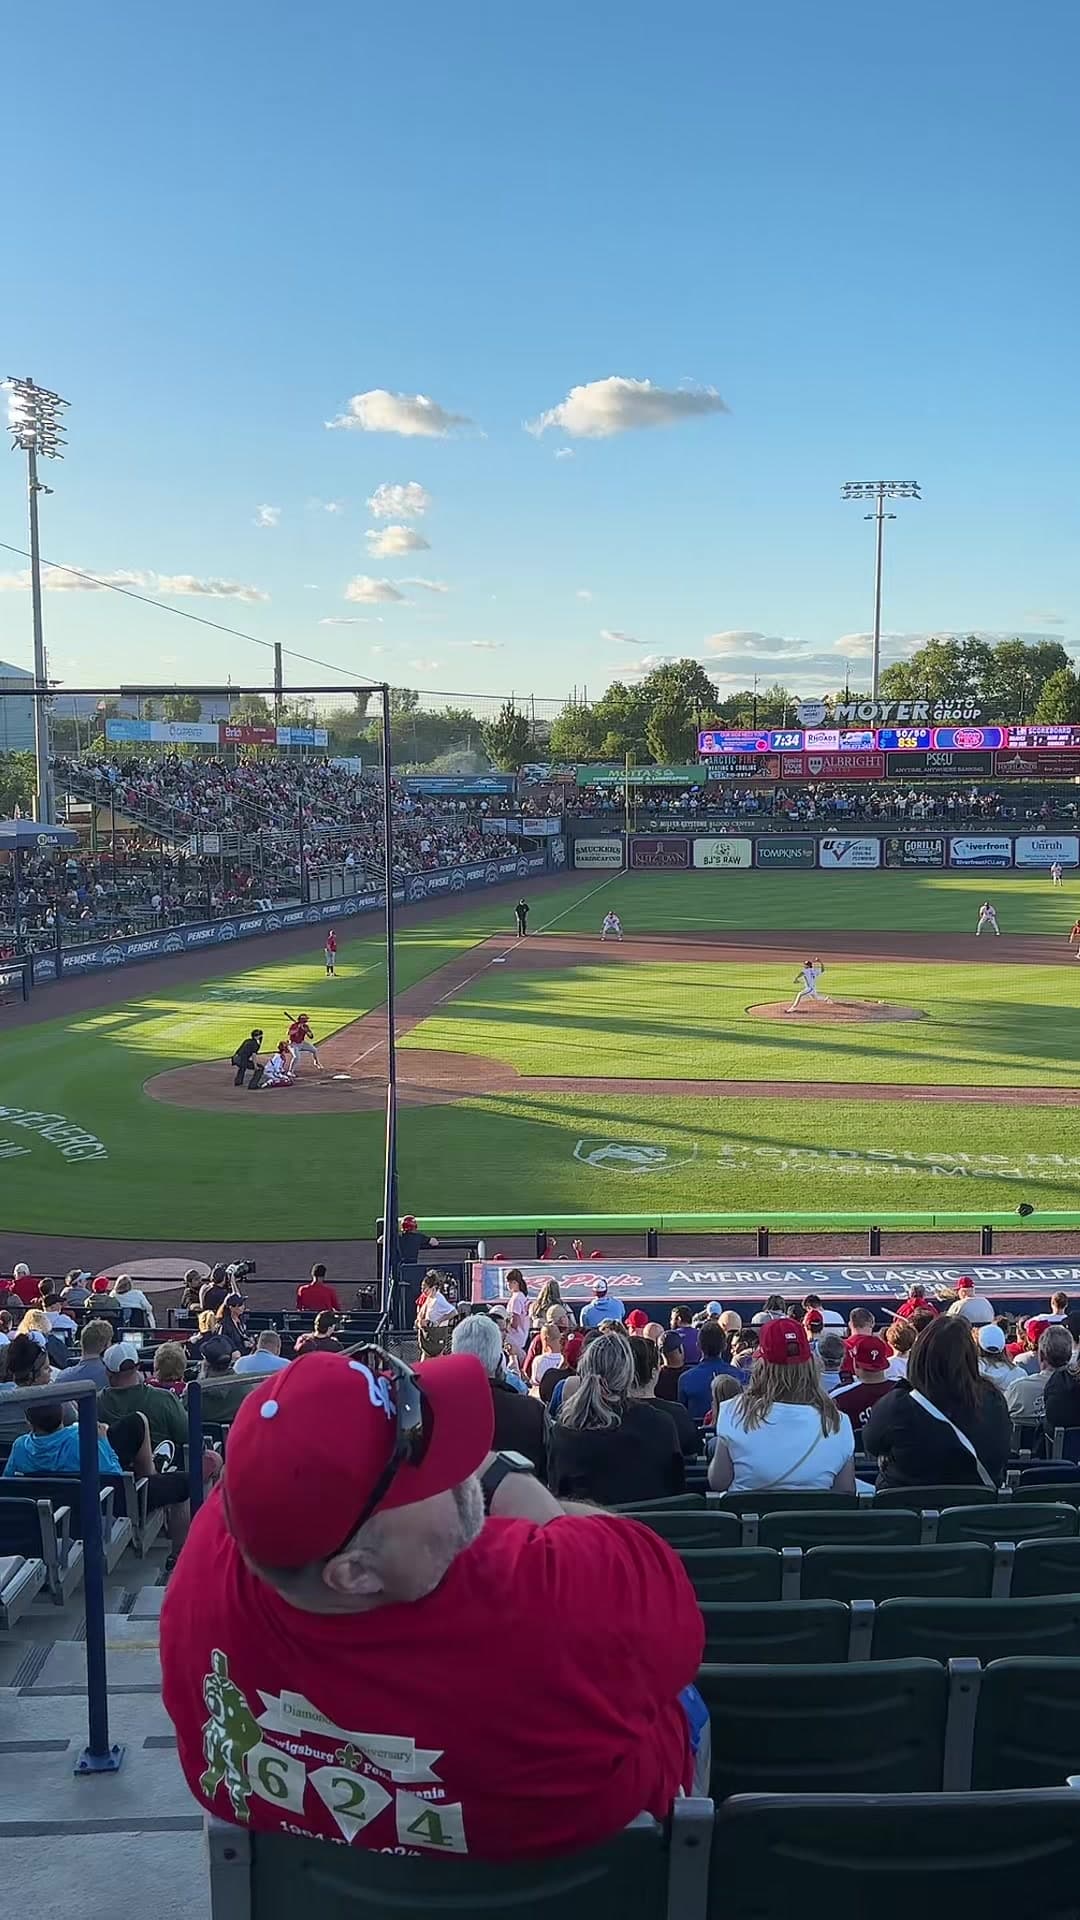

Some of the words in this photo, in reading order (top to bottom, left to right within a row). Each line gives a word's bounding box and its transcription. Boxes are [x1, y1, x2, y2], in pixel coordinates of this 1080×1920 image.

[935, 699, 975, 710] AUTO
[833, 700, 929, 721] MOYER
[934, 709, 981, 720] GROUP
[774, 734, 800, 747] 7:34
[808, 734, 837, 743] RHOADS
[898, 737, 917, 748] 835
[709, 756, 737, 765] ARCTIC
[823, 756, 883, 767] ALBRIGHT
[904, 840, 942, 851] GORILLA
[1031, 840, 1063, 850] Unruh
[759, 848, 802, 858] TOMPKINS
[704, 856, 722, 865] BJ'S
[723, 856, 741, 865] RAW
[127, 939, 160, 954] PENSKE
[62, 952, 98, 967] PENSKE
[11, 1112, 108, 1163] ENERGY
[668, 1268, 830, 1283] AMERICA'S
[841, 1268, 961, 1281] CLASSIC
[863, 1283, 897, 1292] Est.
[283, 1703, 334, 1725] Diamon
[257, 1756, 289, 1799] 6
[331, 1776, 366, 1821] 2
[407, 1807, 454, 1847] 4
